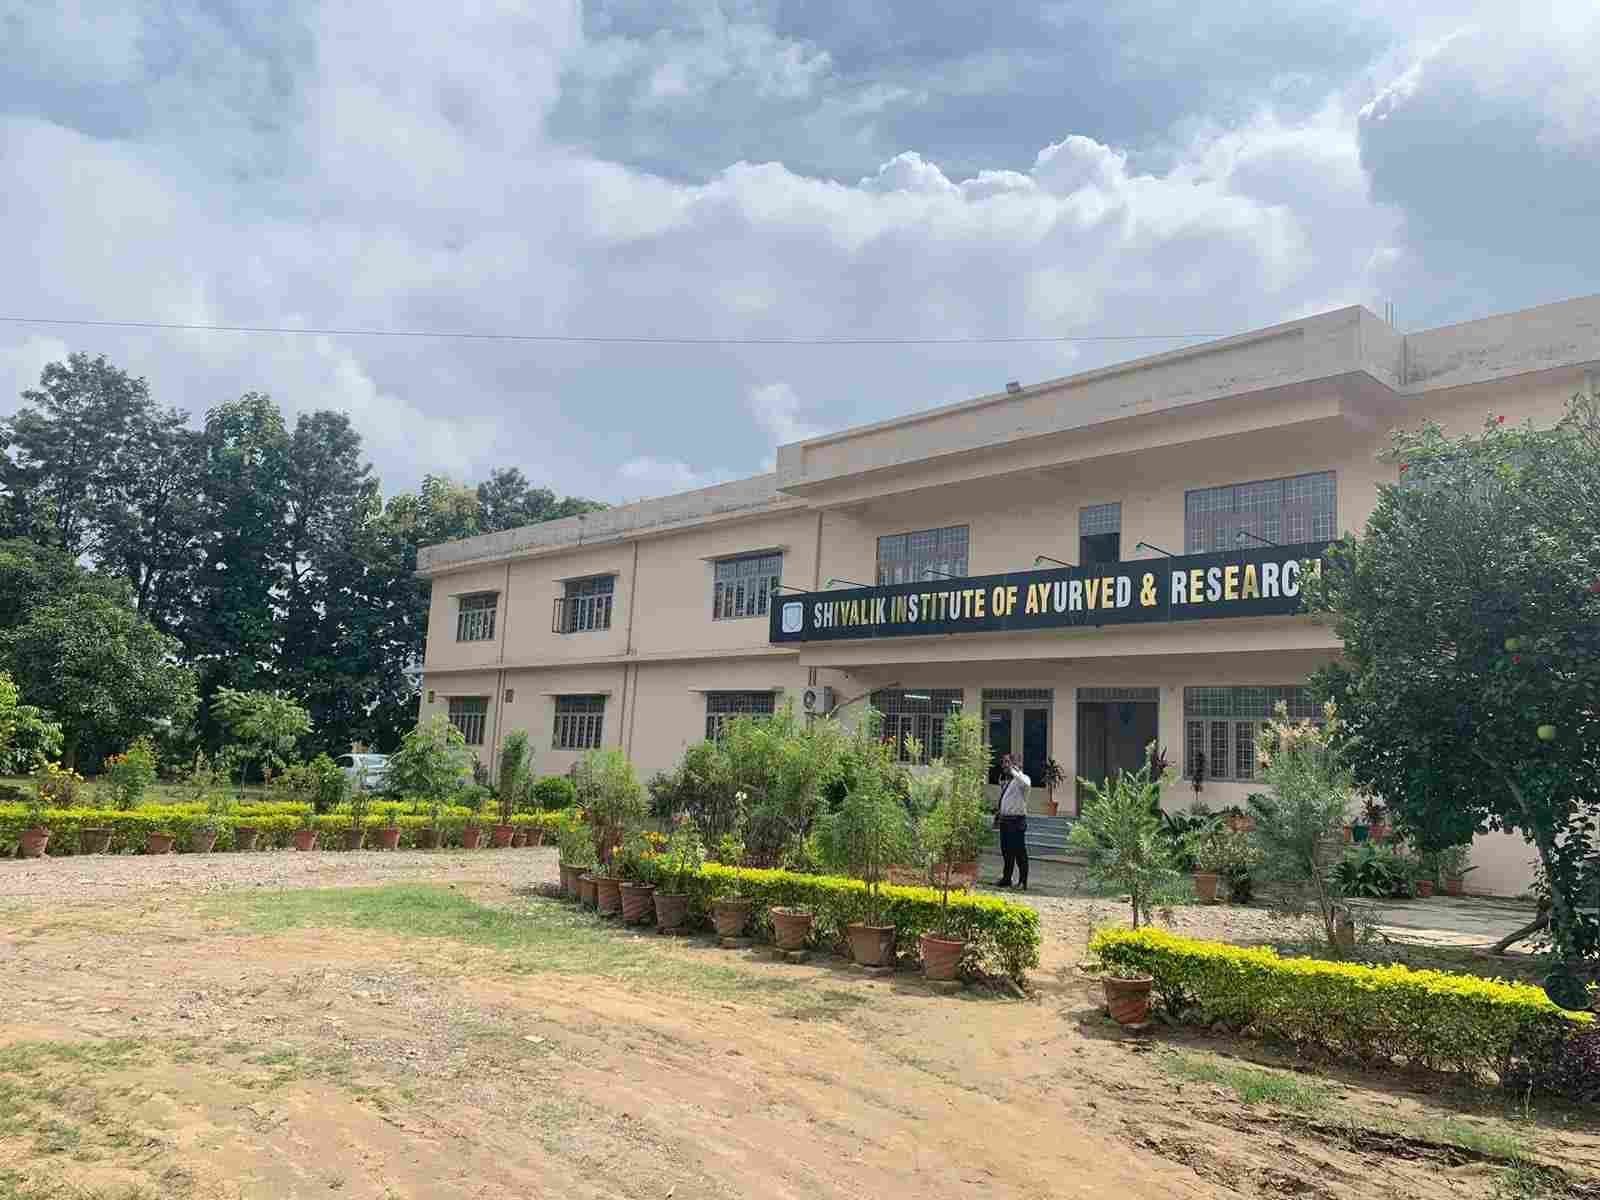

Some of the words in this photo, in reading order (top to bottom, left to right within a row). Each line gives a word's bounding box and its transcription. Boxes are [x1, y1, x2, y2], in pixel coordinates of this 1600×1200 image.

[814, 597, 886, 628] SHIVALIK
[890, 589, 985, 624] INSTITUTE
[992, 586, 1018, 616] OF
[1024, 576, 1131, 614] AYURVED
[1140, 573, 1157, 607] &
[1171, 558, 1321, 604] RESEARC
